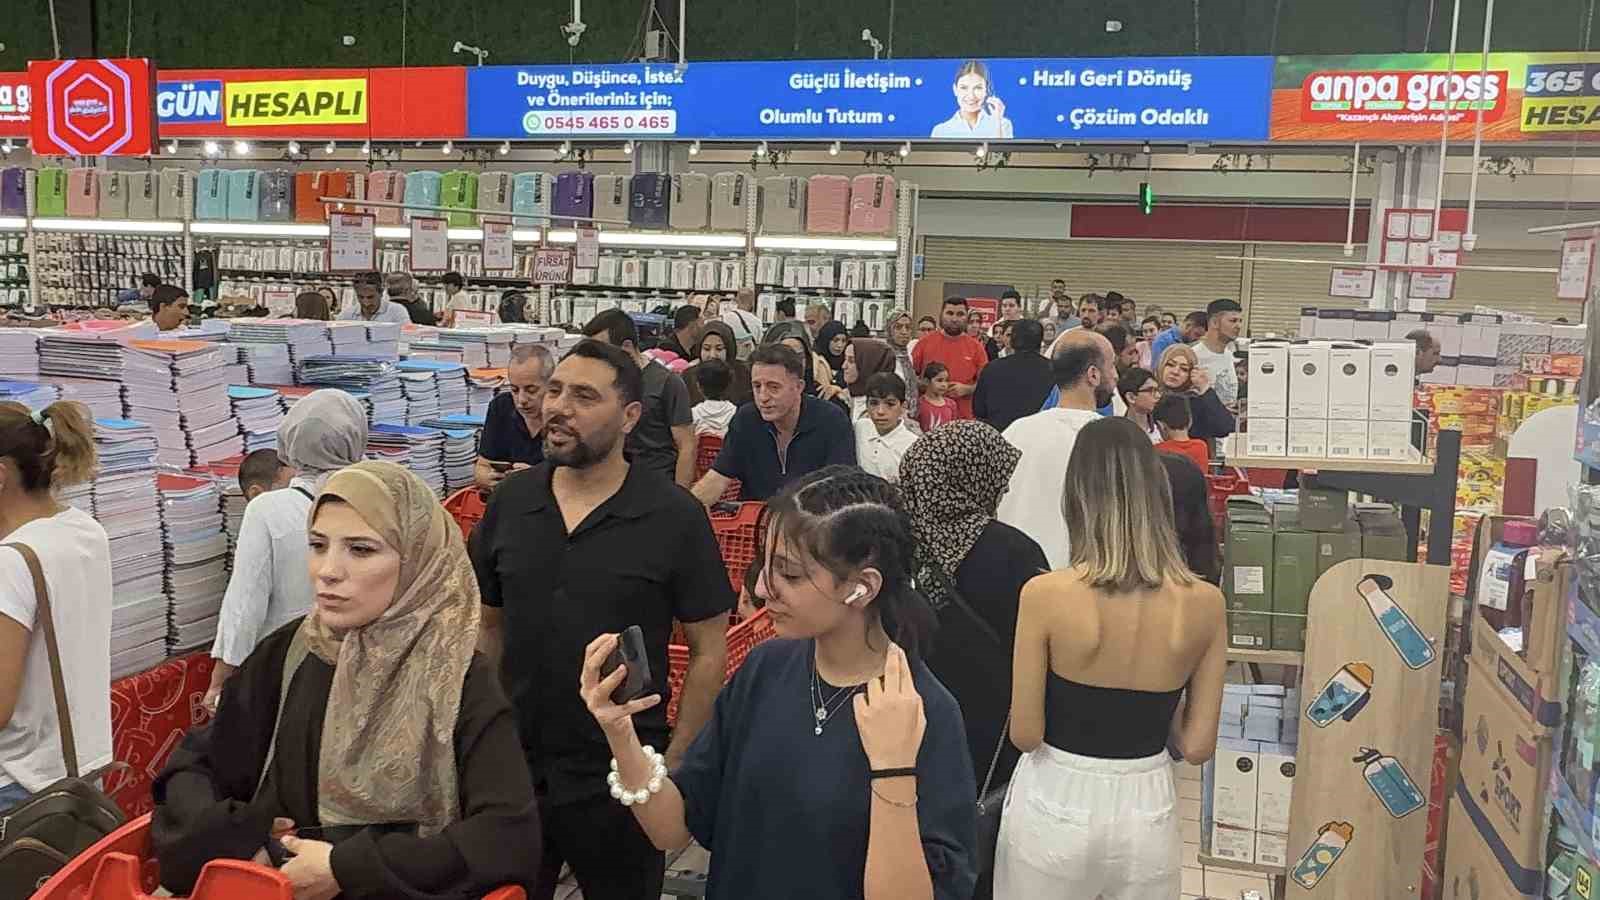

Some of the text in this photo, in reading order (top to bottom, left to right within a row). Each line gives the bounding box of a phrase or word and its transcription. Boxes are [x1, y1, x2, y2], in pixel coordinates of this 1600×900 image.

[517, 71, 569, 89] Duygu,
[572, 70, 641, 88] Düşünce,
[789, 67, 911, 94] Güçlü İletişim
[1032, 68, 1192, 91] Hızlı Geri Dönüş
[1525, 70, 1585, 93] 365
[157, 83, 220, 118] GÜN
[526, 94, 545, 106] ve
[547, 89, 637, 106] Önerileriniz
[1310, 73, 1500, 111] anpa gross
[230, 91, 363, 118] HESAPLI
[759, 108, 883, 124] Olumlu Tutum
[544, 116, 670, 130] 0545 465 0 465
[1069, 107, 1209, 130] Çözüm Odaklı
